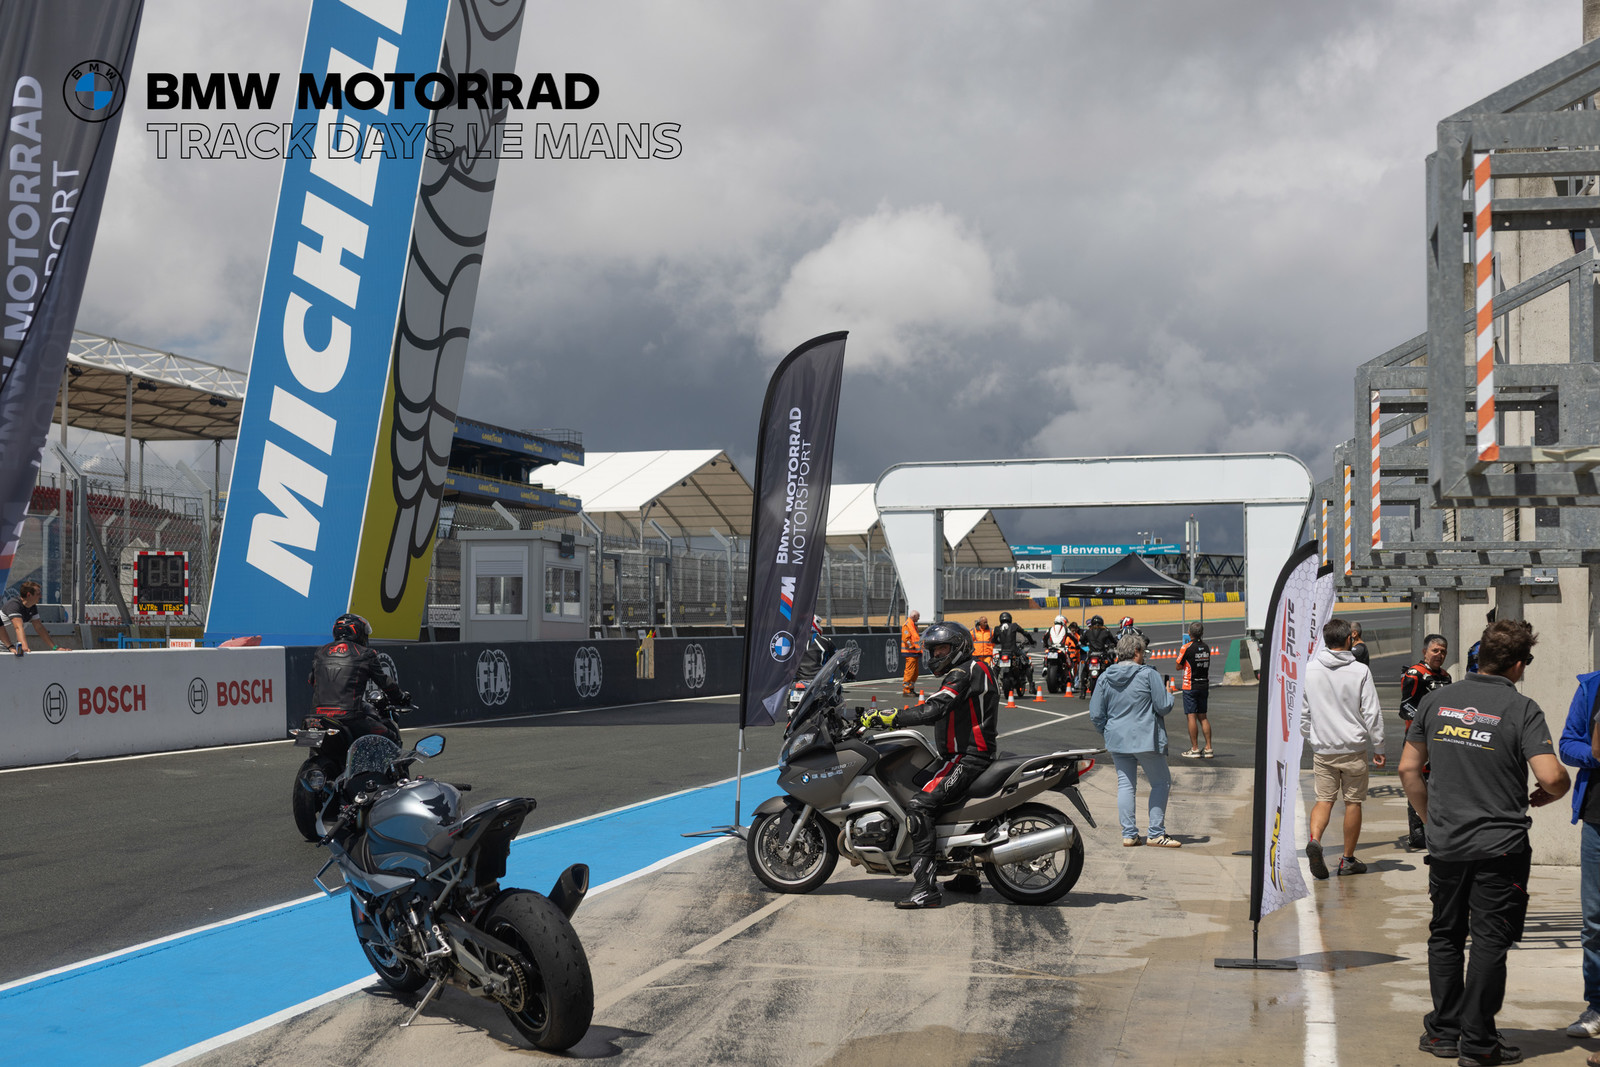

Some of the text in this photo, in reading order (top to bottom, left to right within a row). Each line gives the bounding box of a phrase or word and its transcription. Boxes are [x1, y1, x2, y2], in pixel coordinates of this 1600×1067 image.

[776, 407, 802, 564] BMW MOTORRAD
[792, 439, 811, 565] MOTORSPORT
[1061, 545, 1122, 554] Bienvenue
[78, 684, 146, 715] BOSCH
[216, 678, 273, 707] BOSCH
[1471, 729, 1492, 743] LG
